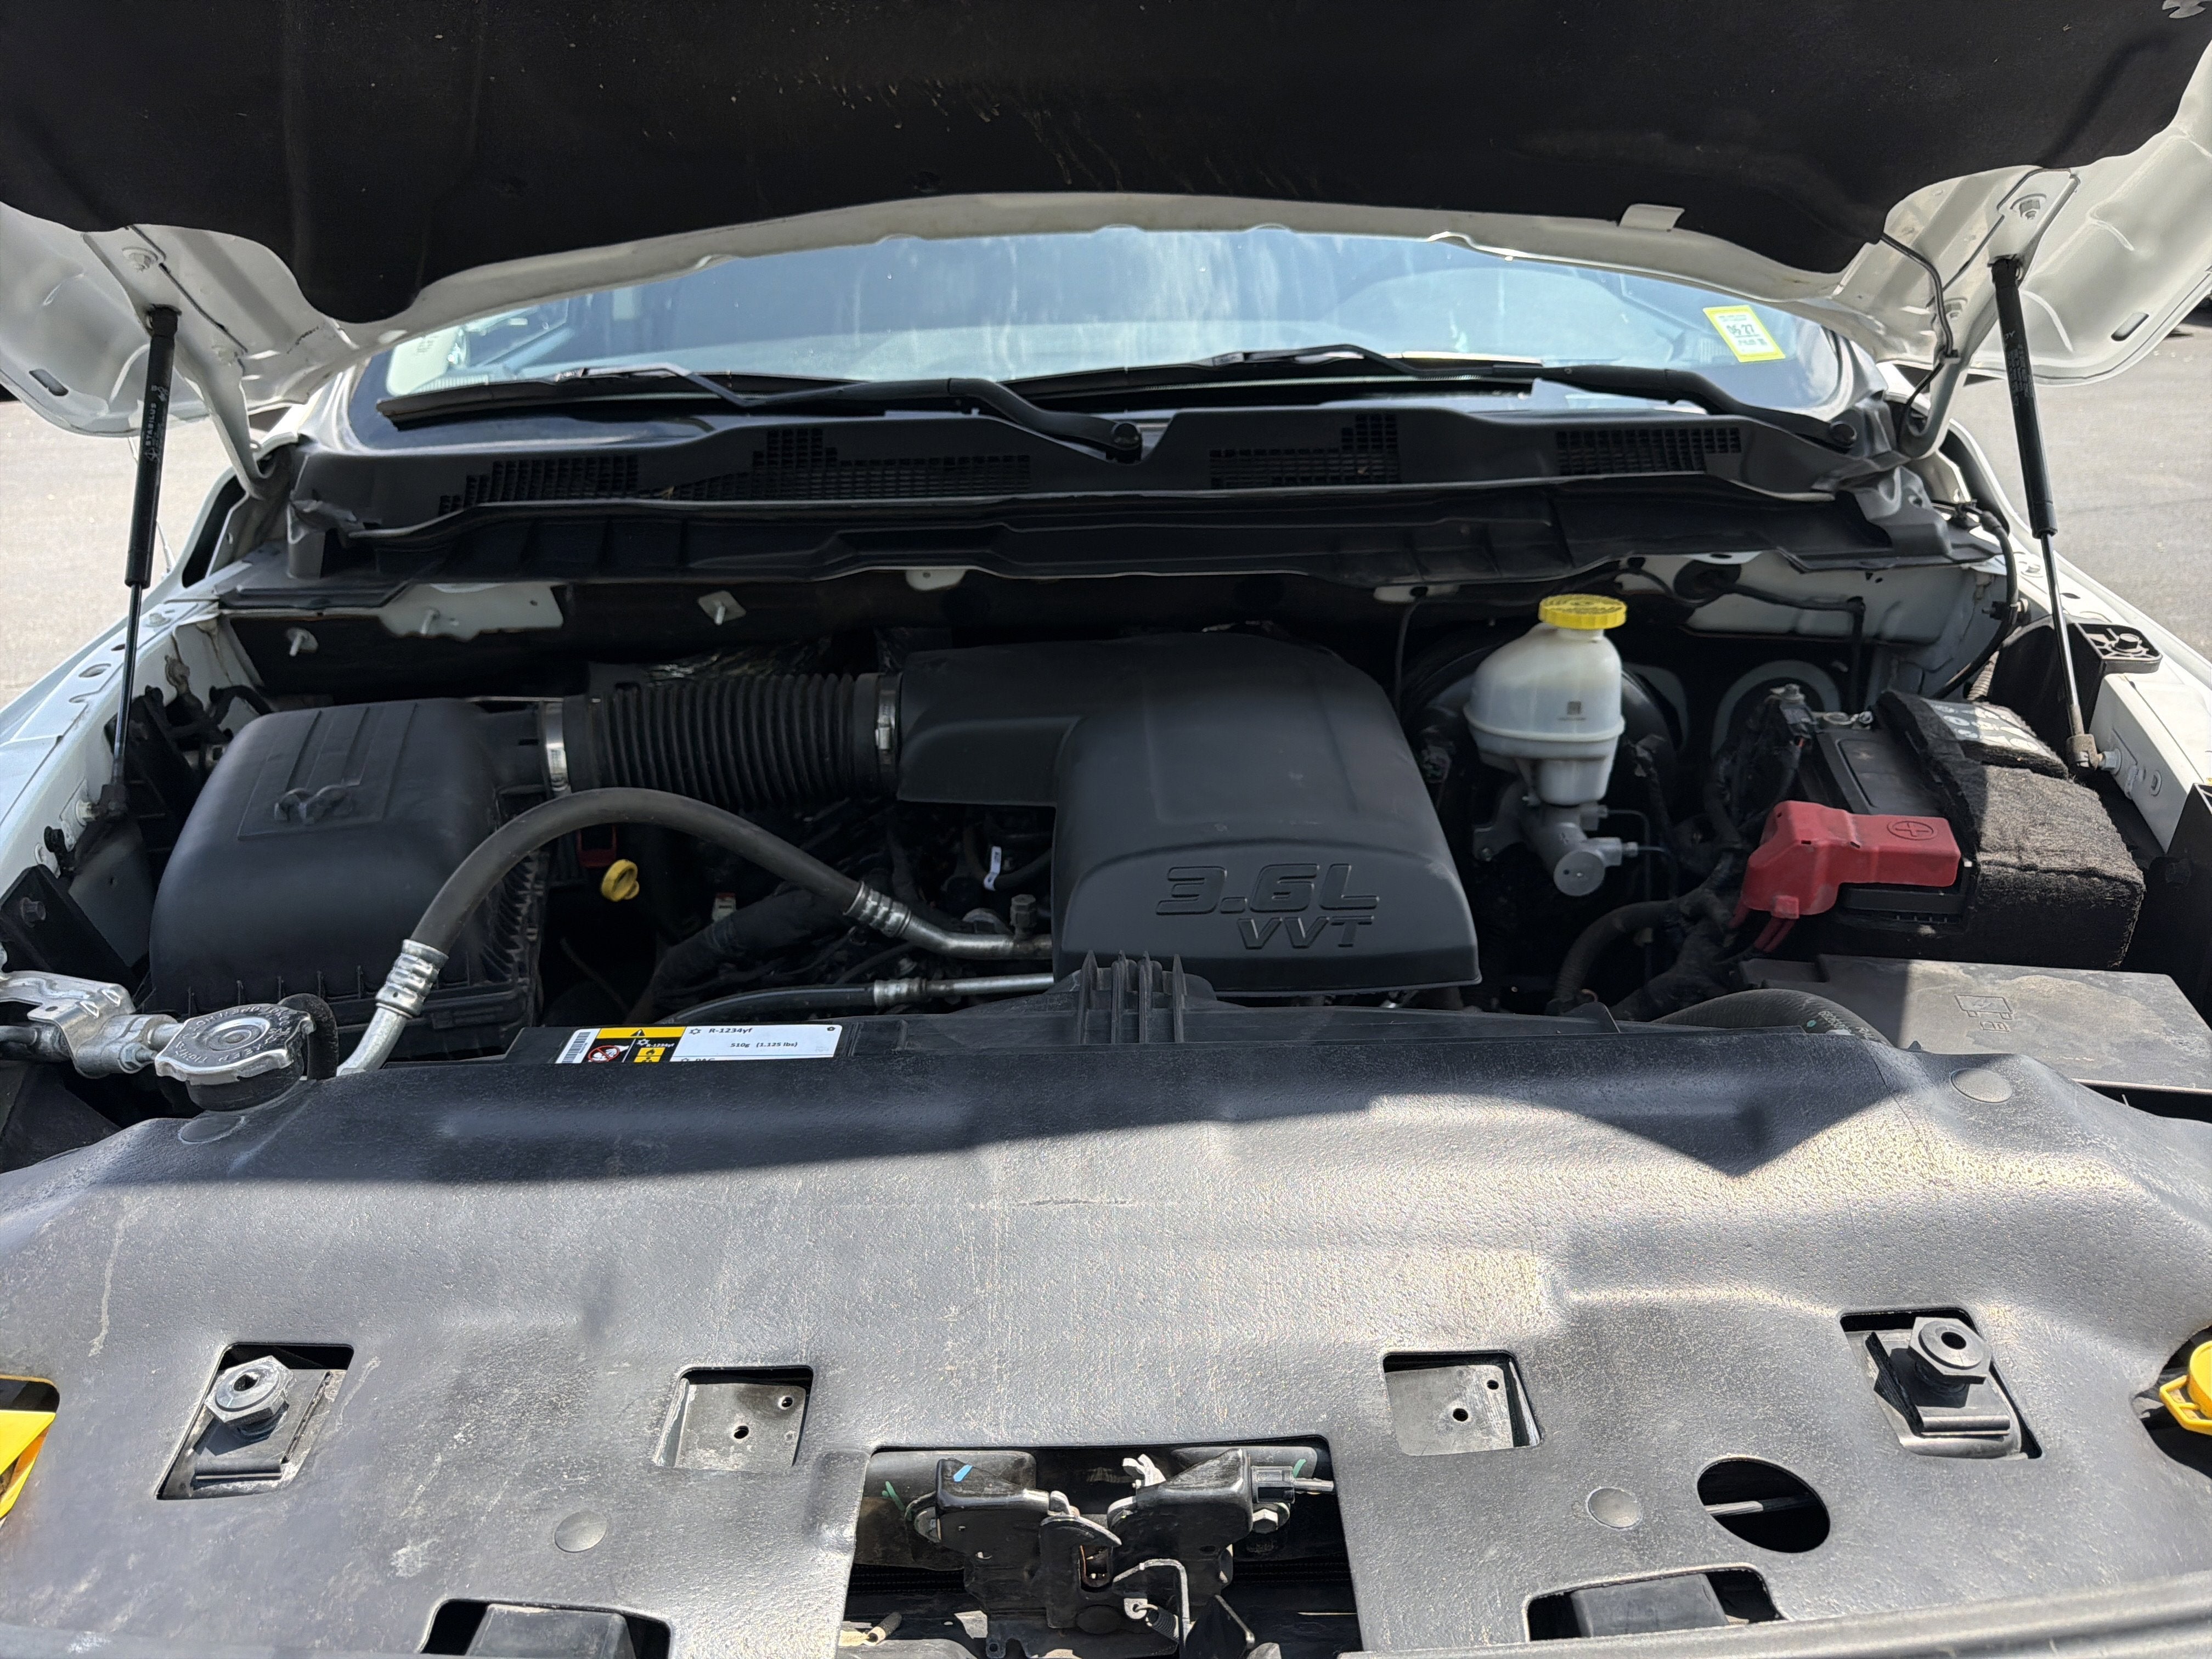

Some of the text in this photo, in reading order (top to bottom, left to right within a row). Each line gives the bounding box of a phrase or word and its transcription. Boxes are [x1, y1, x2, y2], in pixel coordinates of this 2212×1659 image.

[145, 403, 157, 446] STABILUS
[1156, 864, 1380, 915] 3.6L
[1237, 915, 1374, 950] VVT
[174, 1048, 208, 1063] TIGHT
